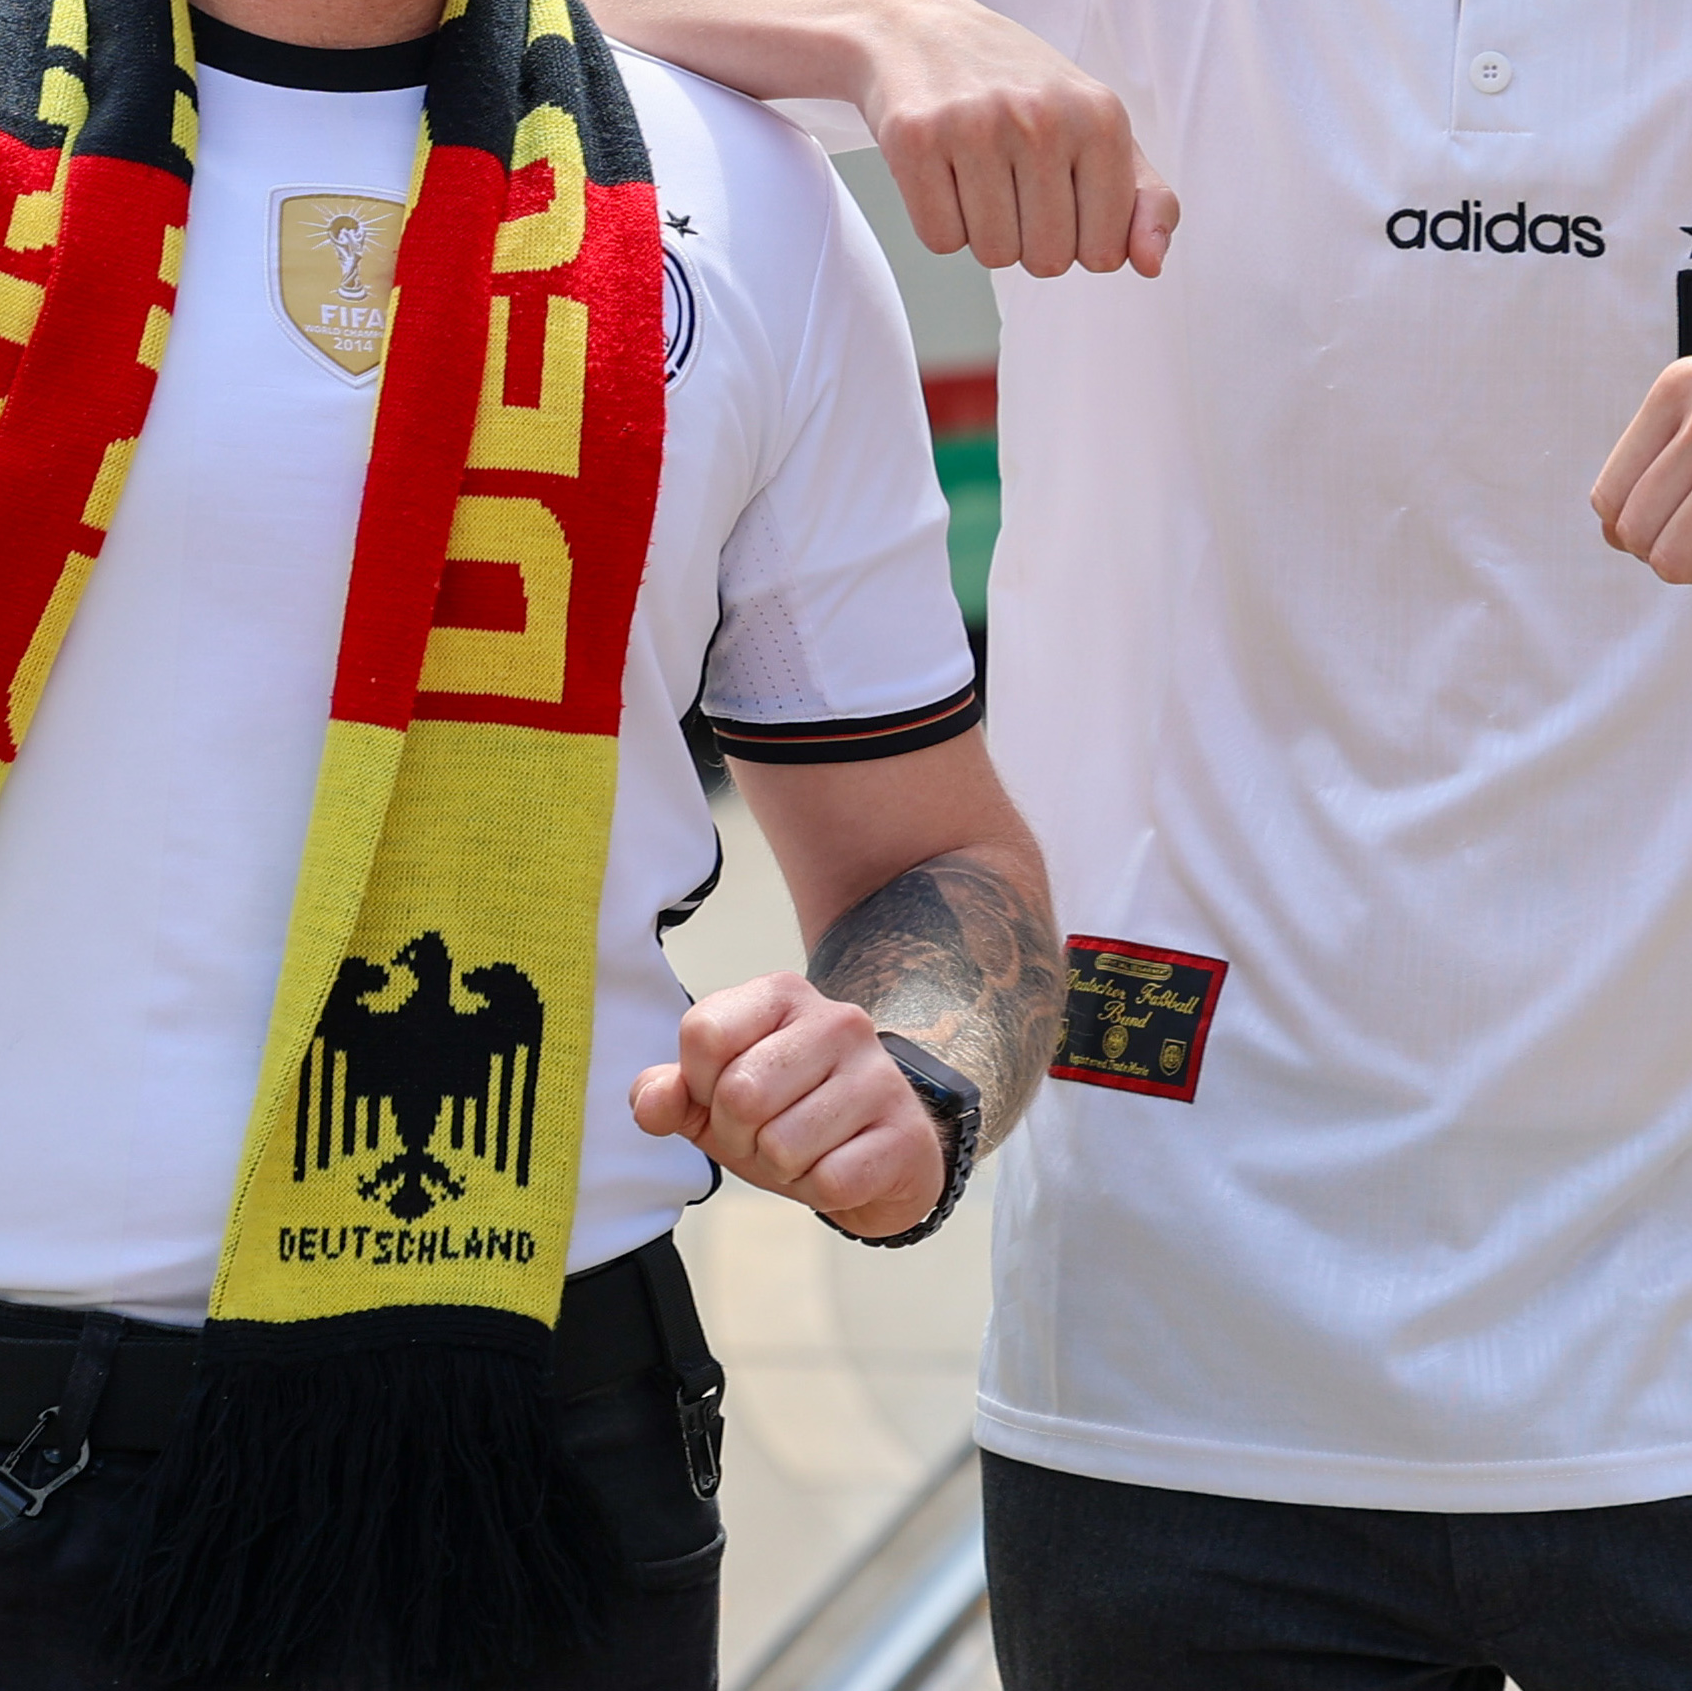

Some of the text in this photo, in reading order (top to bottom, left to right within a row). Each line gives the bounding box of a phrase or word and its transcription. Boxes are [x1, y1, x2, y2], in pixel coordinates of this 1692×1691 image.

[1386, 200, 1606, 258] adidas
[320, 304, 384, 329] FIFA
[303, 324, 341, 336] WORLD
[333, 337, 373, 352] 2014
[1097, 1000, 1154, 1028] Bund
[278, 1225, 537, 1265] DEUTSCHLAND
